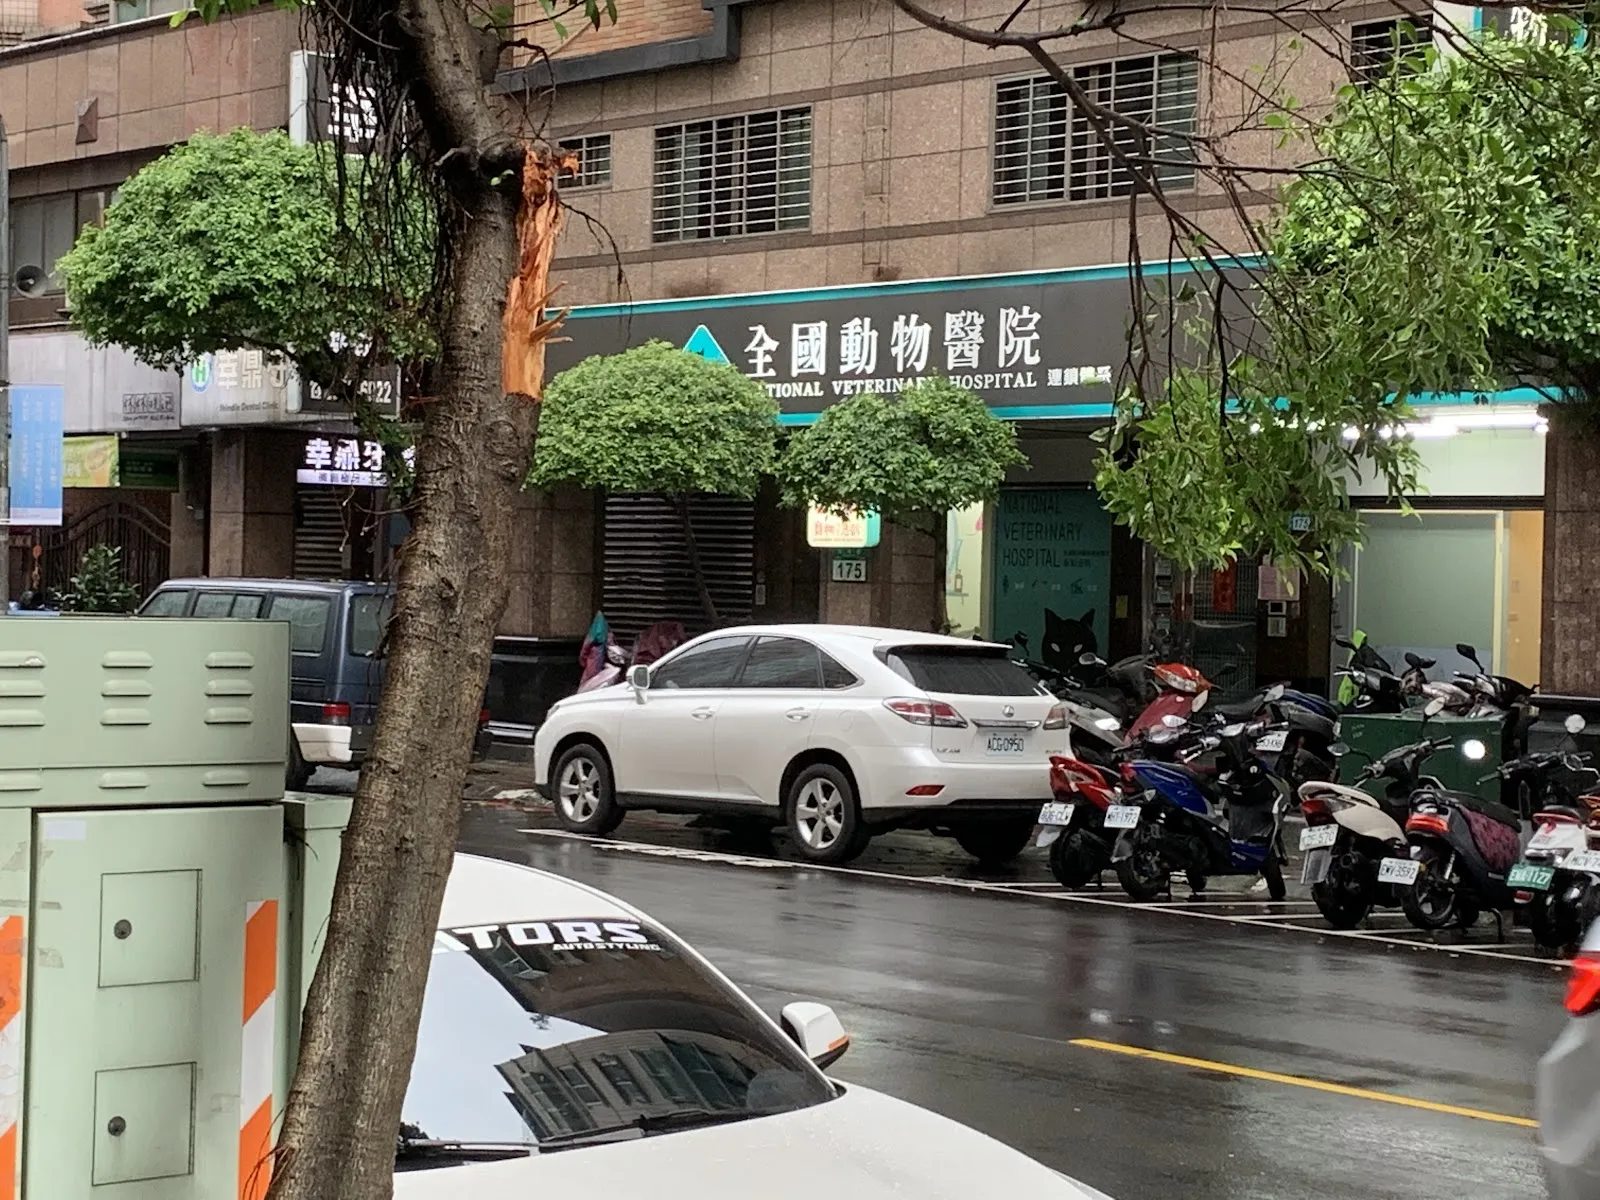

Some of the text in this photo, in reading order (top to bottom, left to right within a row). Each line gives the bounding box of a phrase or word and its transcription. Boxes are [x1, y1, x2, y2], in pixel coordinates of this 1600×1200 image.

[743, 304, 1043, 378] 全國動物醫院
[764, 381, 825, 399] TIONAL
[949, 371, 1038, 390] HOSPITAL
[1002, 493, 1062, 515] NATIONAL
[1002, 521, 1083, 542] VETERINARY
[1002, 547, 1061, 568] HOSPITAL
[837, 561, 863, 579] 175
